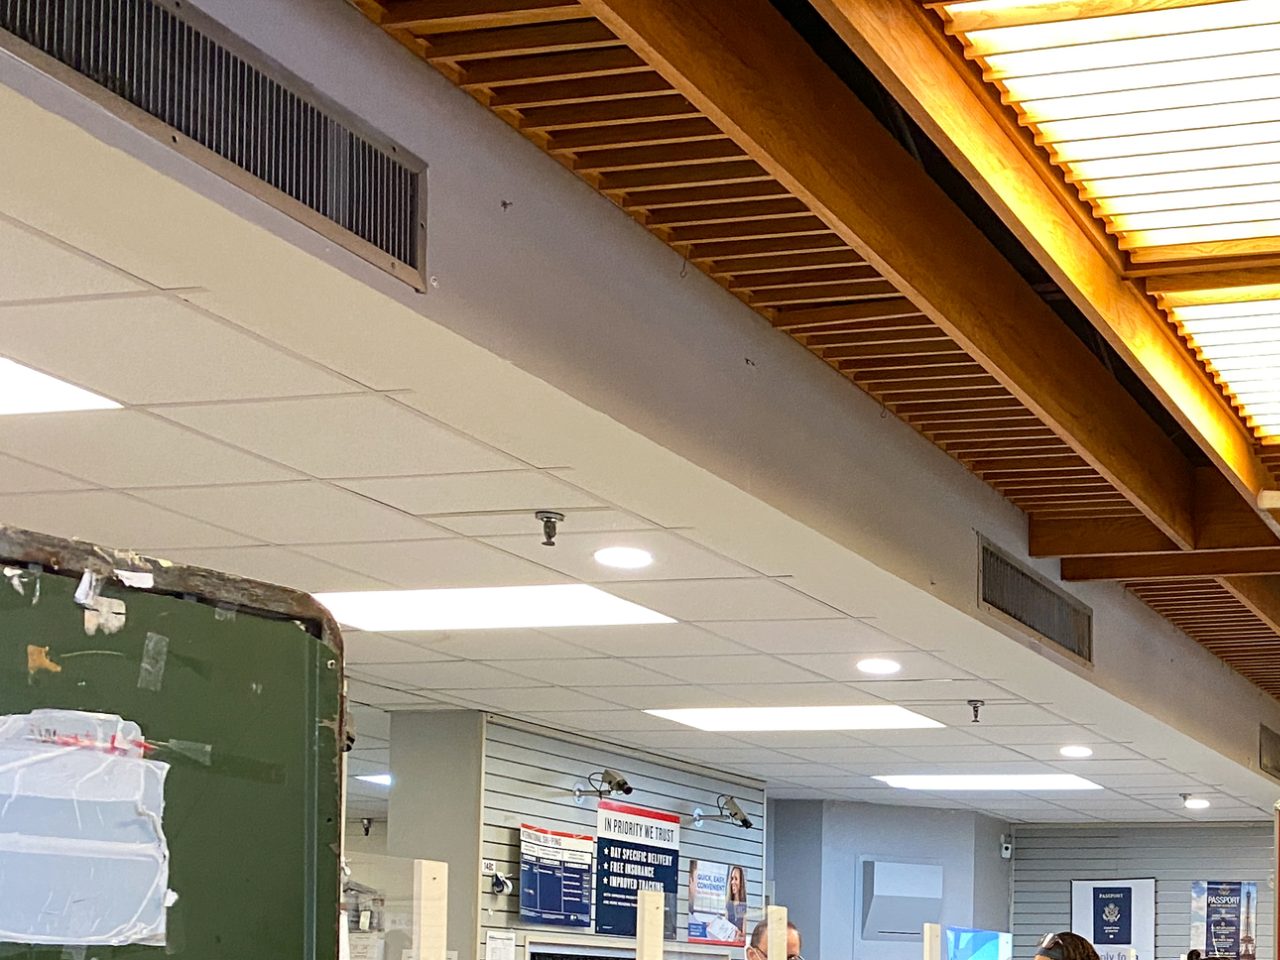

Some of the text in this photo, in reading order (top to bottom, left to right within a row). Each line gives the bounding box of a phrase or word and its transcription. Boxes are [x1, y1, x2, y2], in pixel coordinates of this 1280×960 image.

[604, 817, 674, 842] IN PRIORITY WE TRUST
[610, 847, 673, 866] DAY SPECIFIC DELIVERY
[610, 861, 654, 878] FREE INSURANCE
[609, 876, 638, 889] IMPROVED
[1208, 896, 1240, 904] PASSPORT
